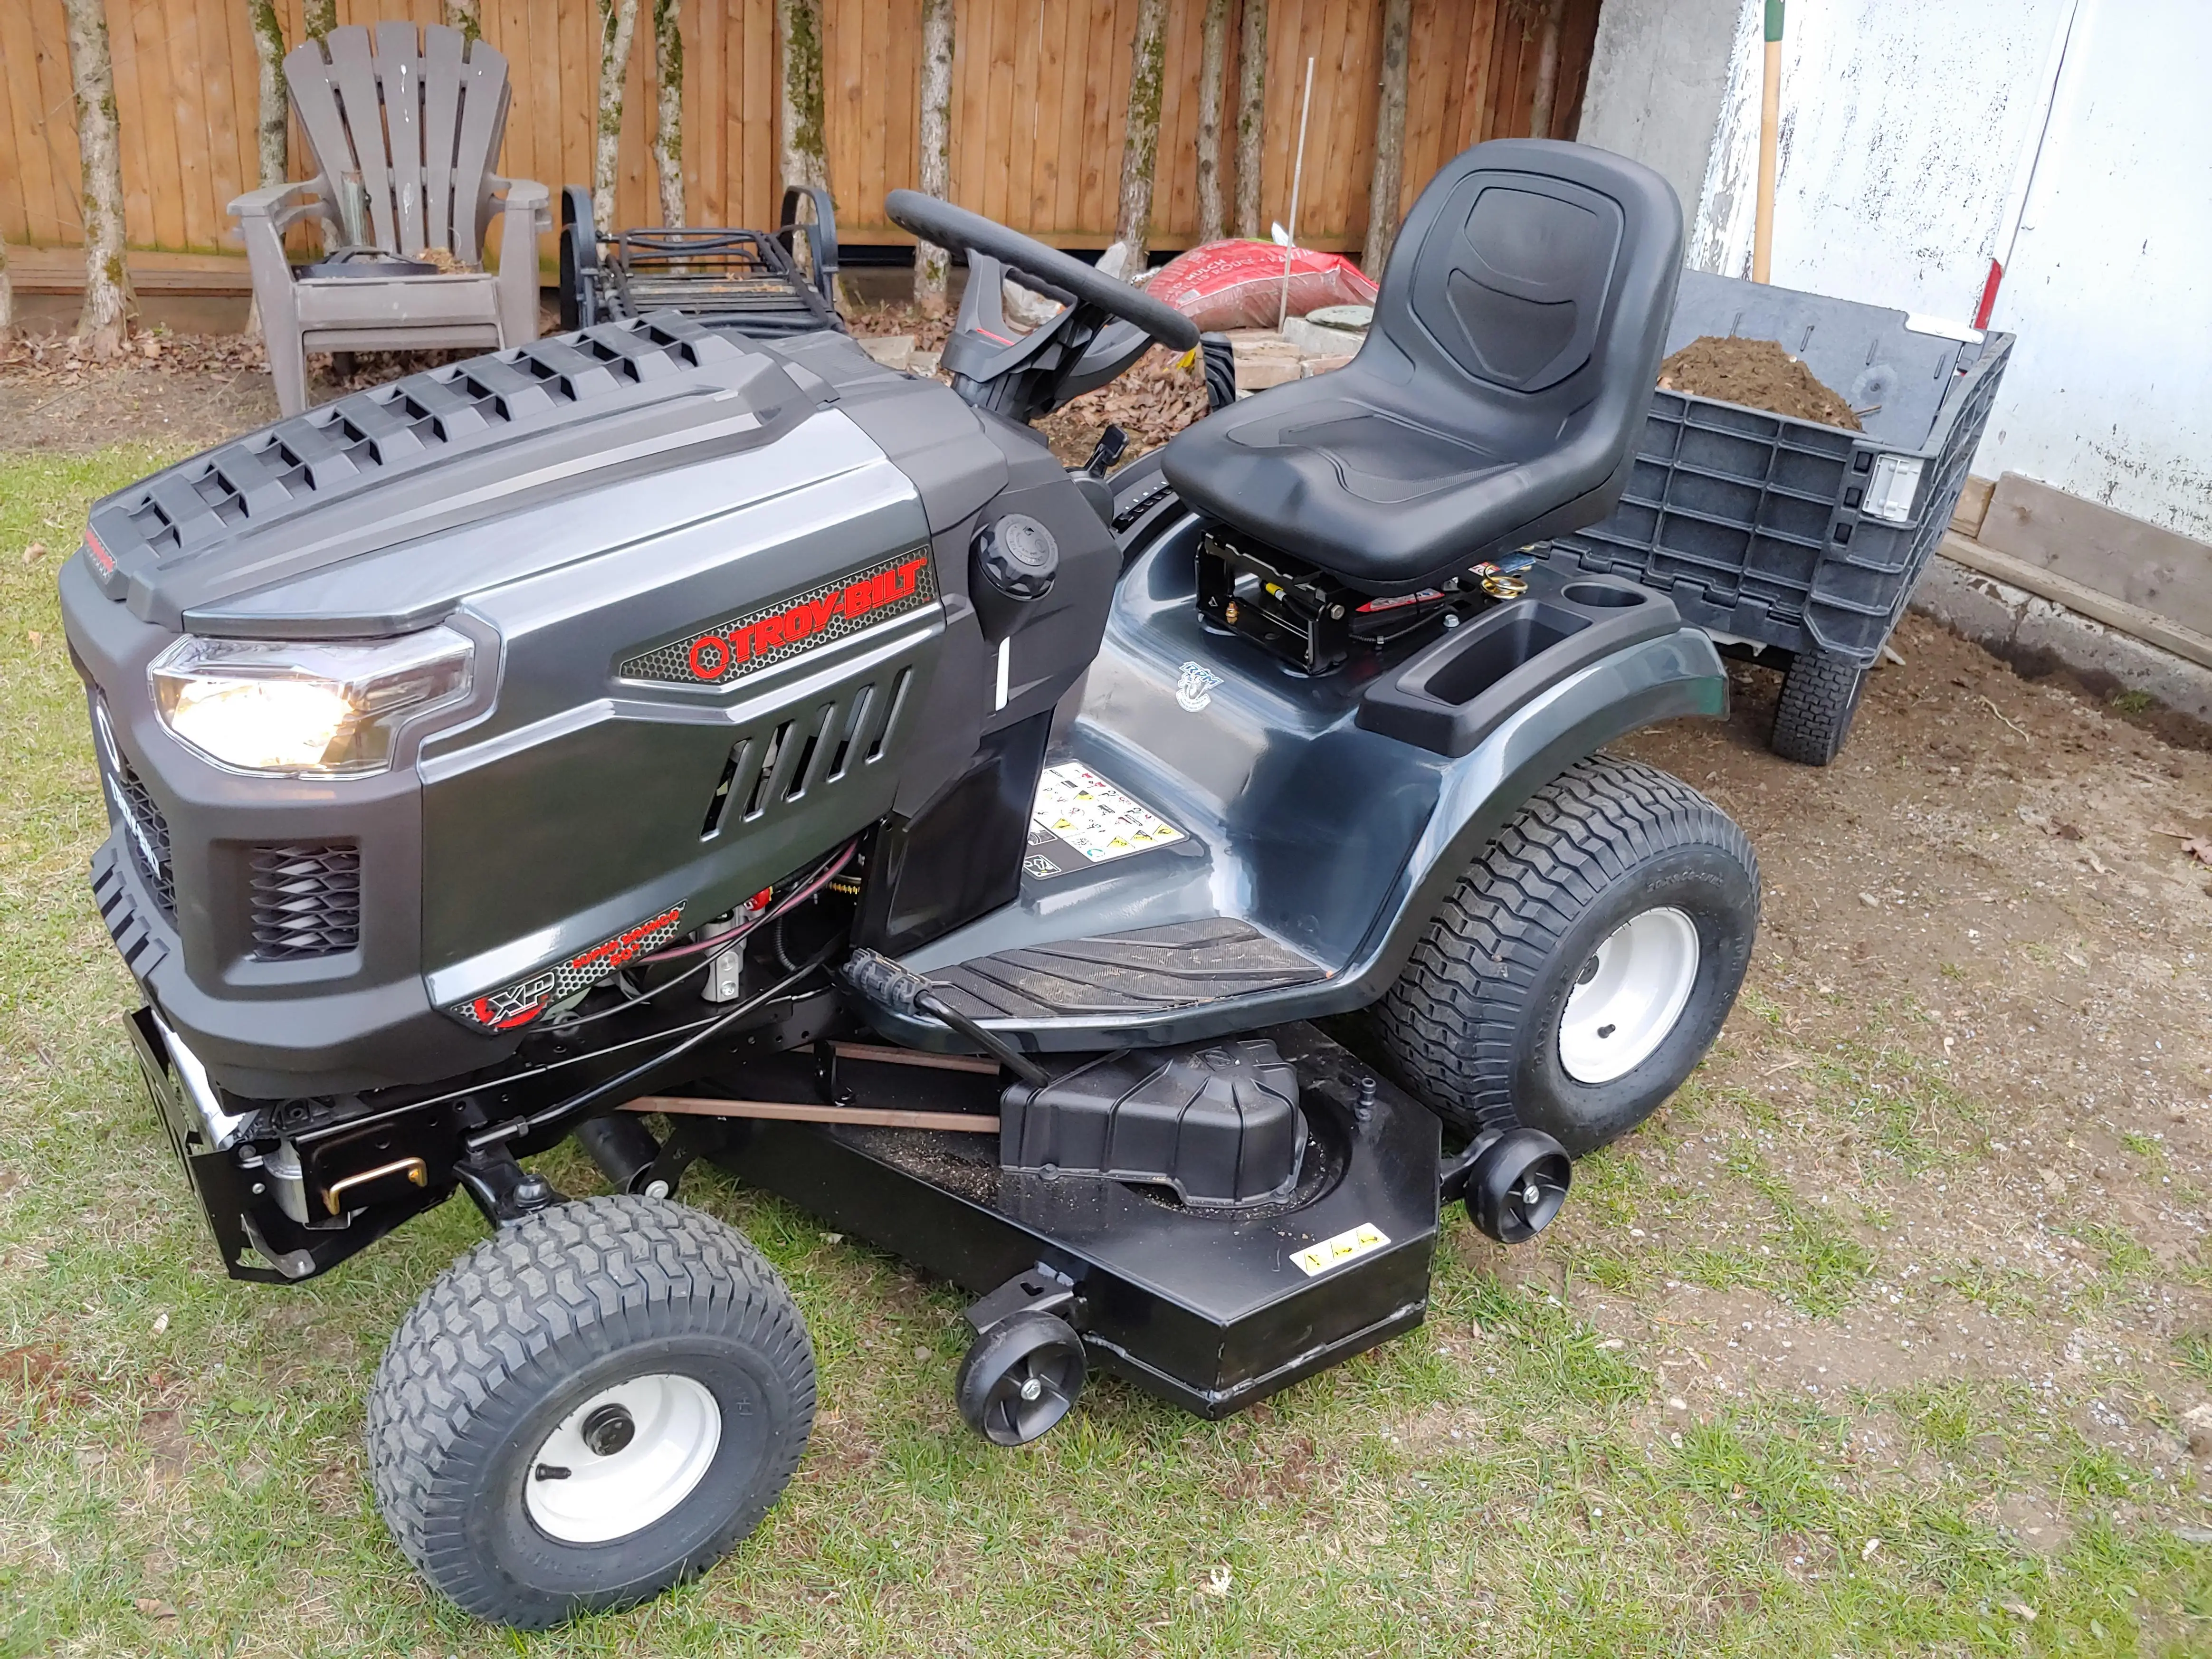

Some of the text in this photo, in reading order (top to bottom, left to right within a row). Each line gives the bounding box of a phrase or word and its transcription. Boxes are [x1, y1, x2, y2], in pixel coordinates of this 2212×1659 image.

[1185, 259, 1227, 281] MULCH
[729, 559, 921, 663] TROY-BILT
[572, 909, 679, 969] SUPER BRONCO
[610, 943, 640, 966] 50"
[487, 972, 555, 1025] XP
